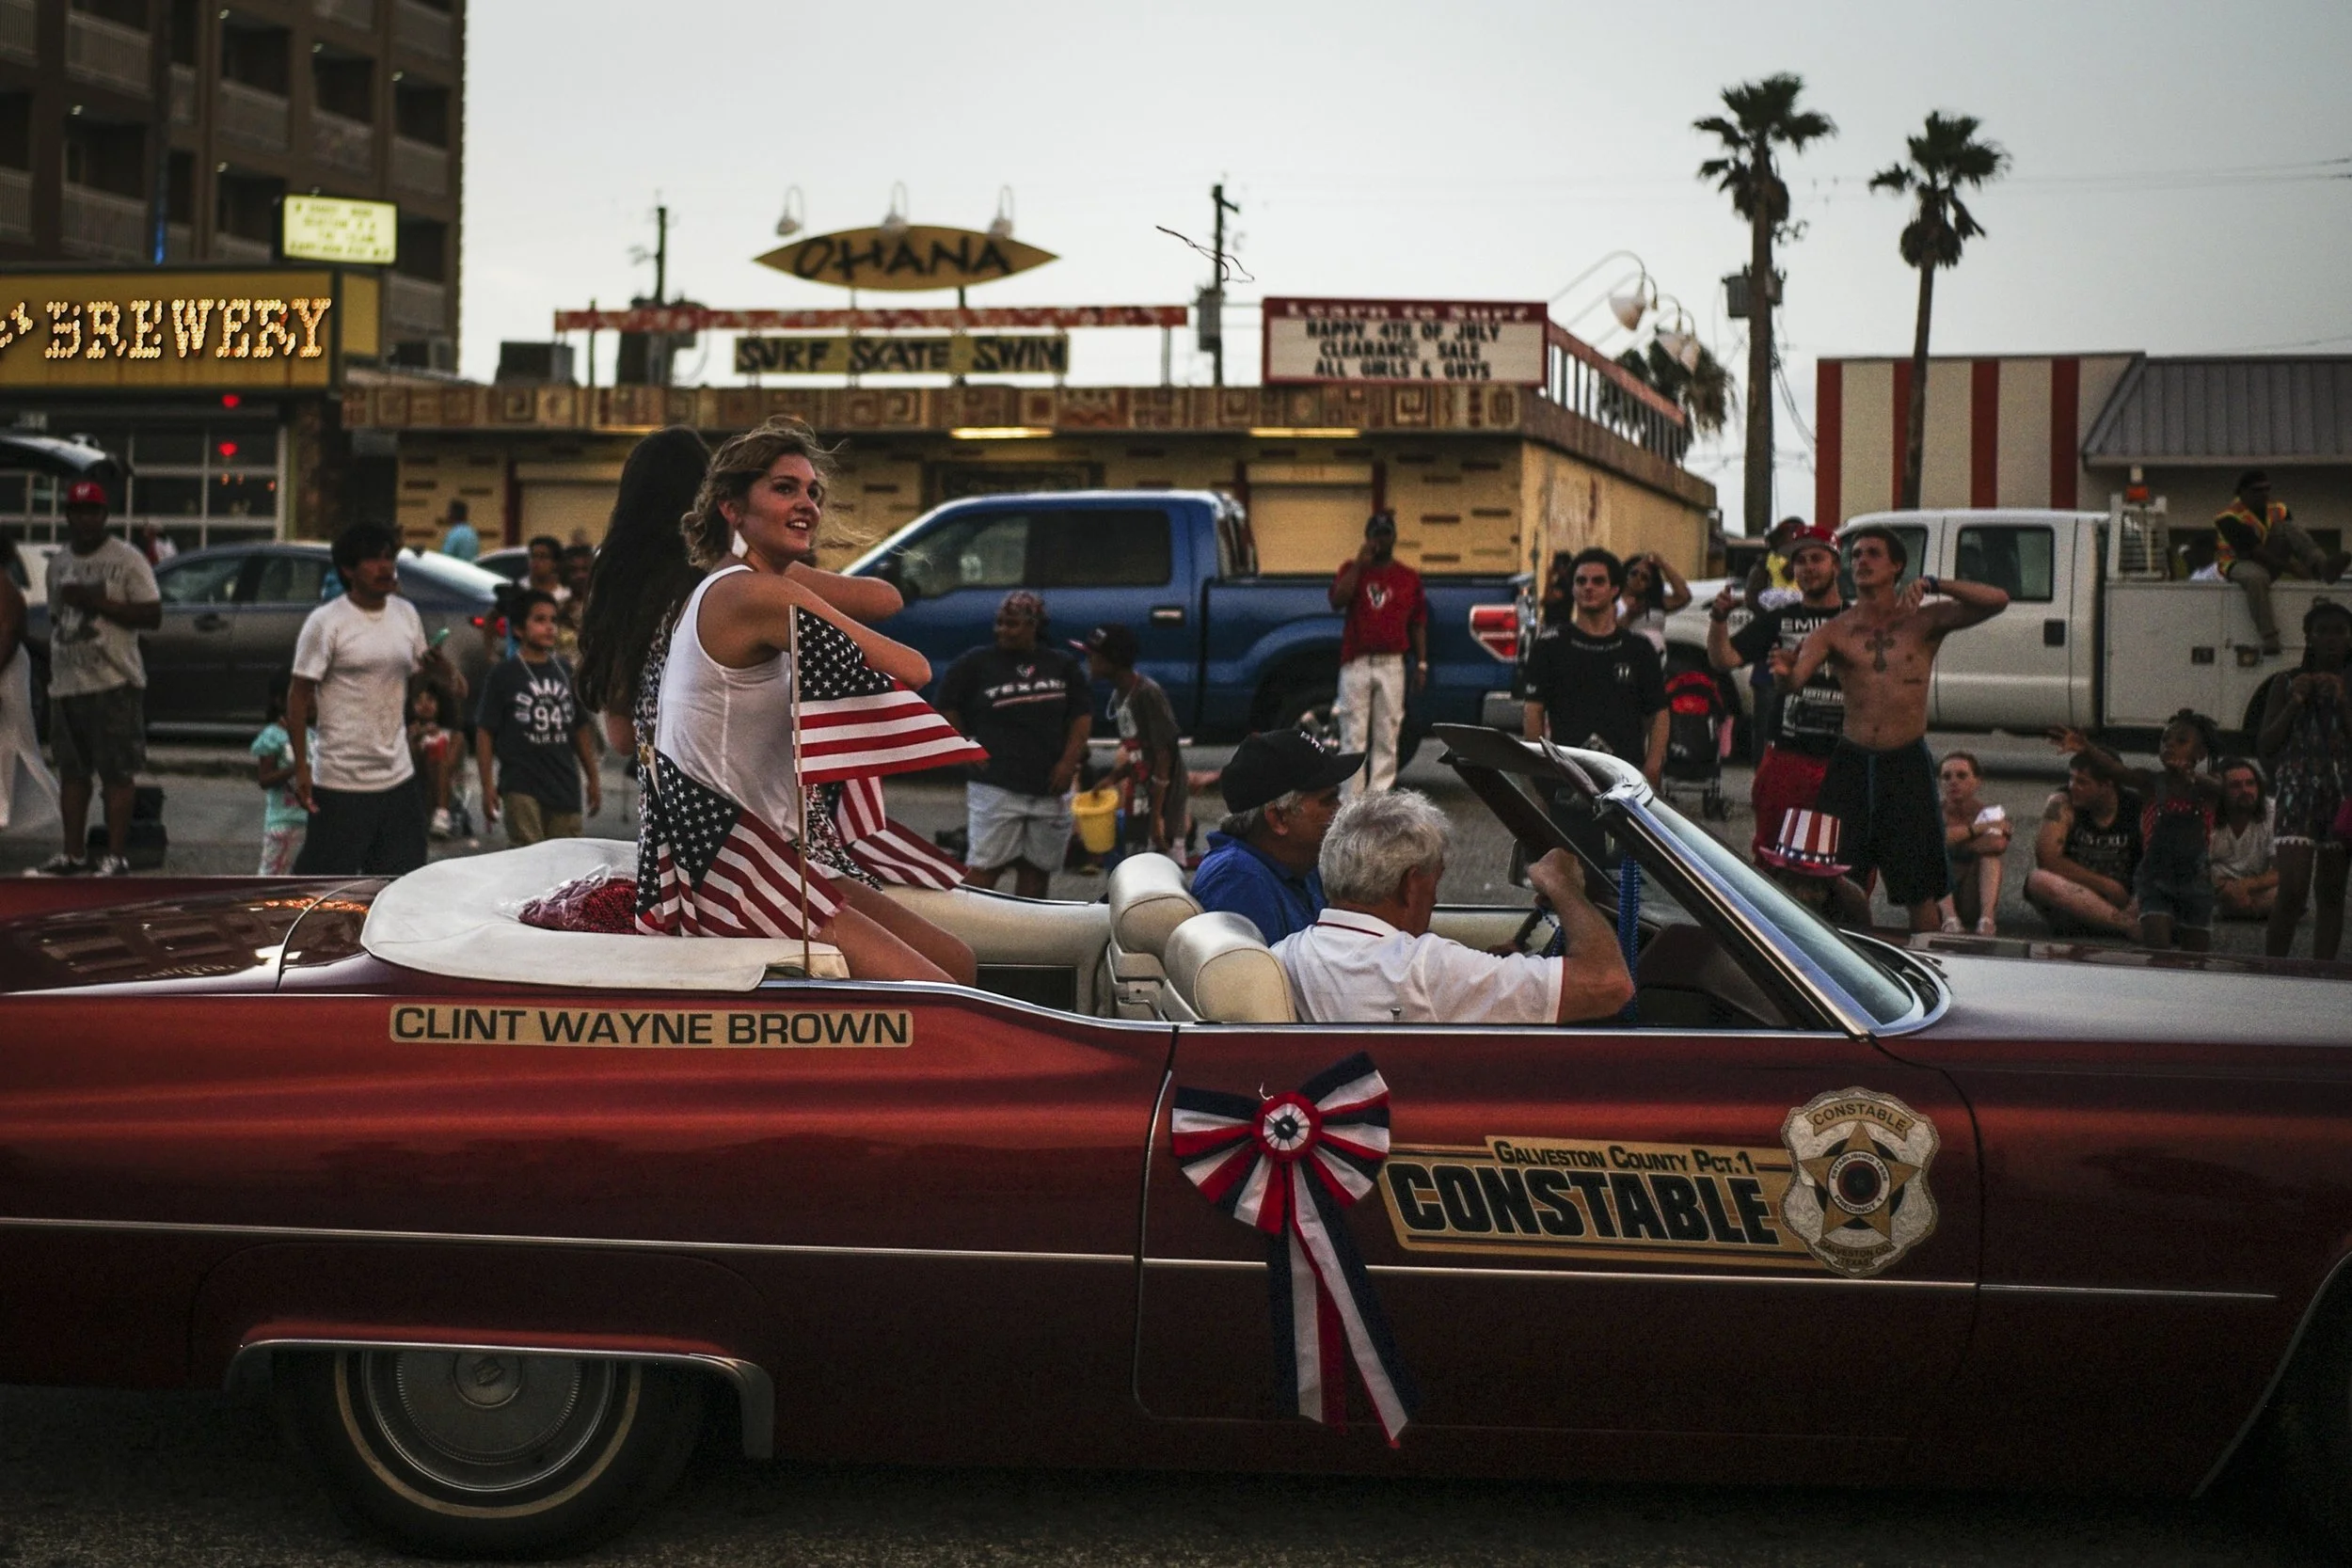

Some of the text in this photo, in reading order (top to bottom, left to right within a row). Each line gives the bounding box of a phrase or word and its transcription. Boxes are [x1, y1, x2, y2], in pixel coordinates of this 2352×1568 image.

[794, 235, 1013, 280] OHANA
[45, 297, 332, 358] BREWERY
[1306, 317, 1501, 342] HAPPY 4TH OF JULY
[739, 336, 1067, 372] SURF SKATE SWIM
[1319, 341, 1480, 360] CLEARANCE SALE
[1314, 358, 1346, 377] ALL
[1359, 359, 1410, 378] GIRLS
[1443, 361, 1491, 381] GUYS
[533, 705, 564, 731] 94
[394, 1006, 908, 1045] CLINT WAYNE BROWN
[1813, 1103, 1907, 1132] CONSTABLE
[1831, 1153, 1876, 1180] ESTABLISHED
[1384, 1161, 1782, 1246] CONSTABLE
[1834, 1195, 1876, 1212] PRECINCT
[1819, 1240, 1874, 1258] GALVESTON
[1840, 1258, 1869, 1266] TEXAS
